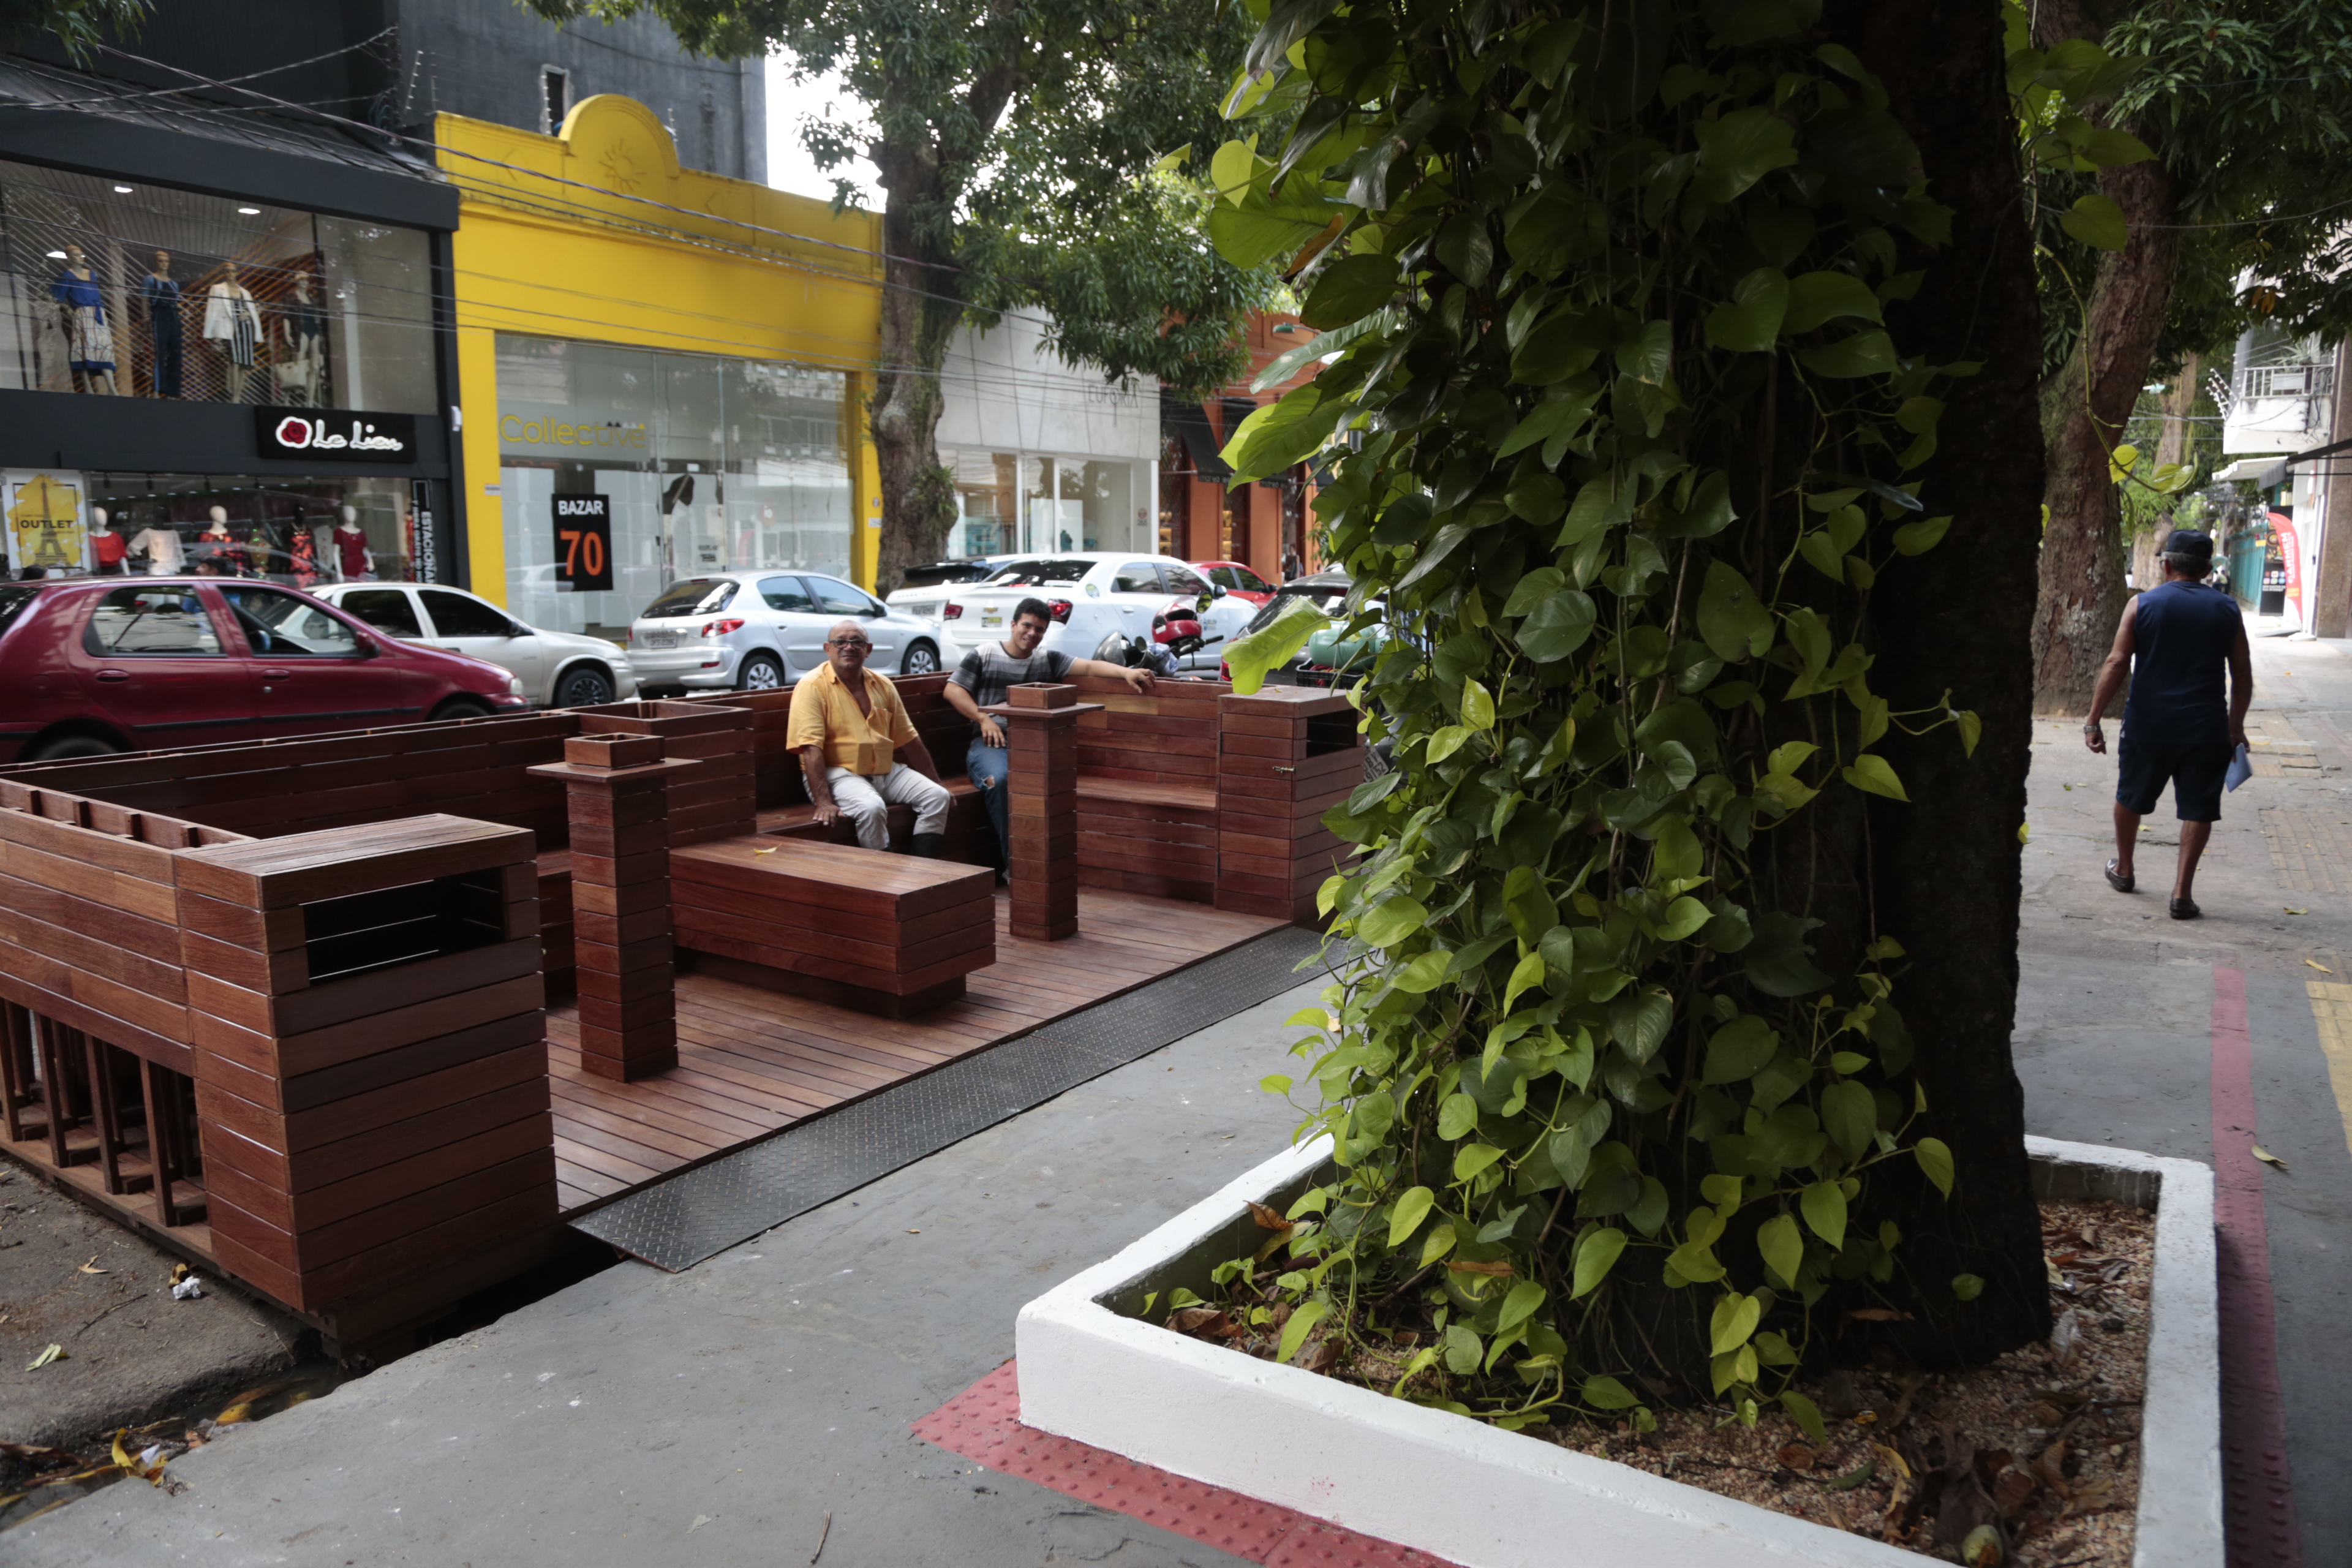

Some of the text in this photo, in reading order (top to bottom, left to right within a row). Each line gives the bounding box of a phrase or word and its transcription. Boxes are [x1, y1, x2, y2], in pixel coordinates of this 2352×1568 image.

[312, 419, 347, 448] Le
[499, 414, 646, 448] Collective
[558, 500, 604, 515] BAZAR
[560, 530, 604, 576] 70
